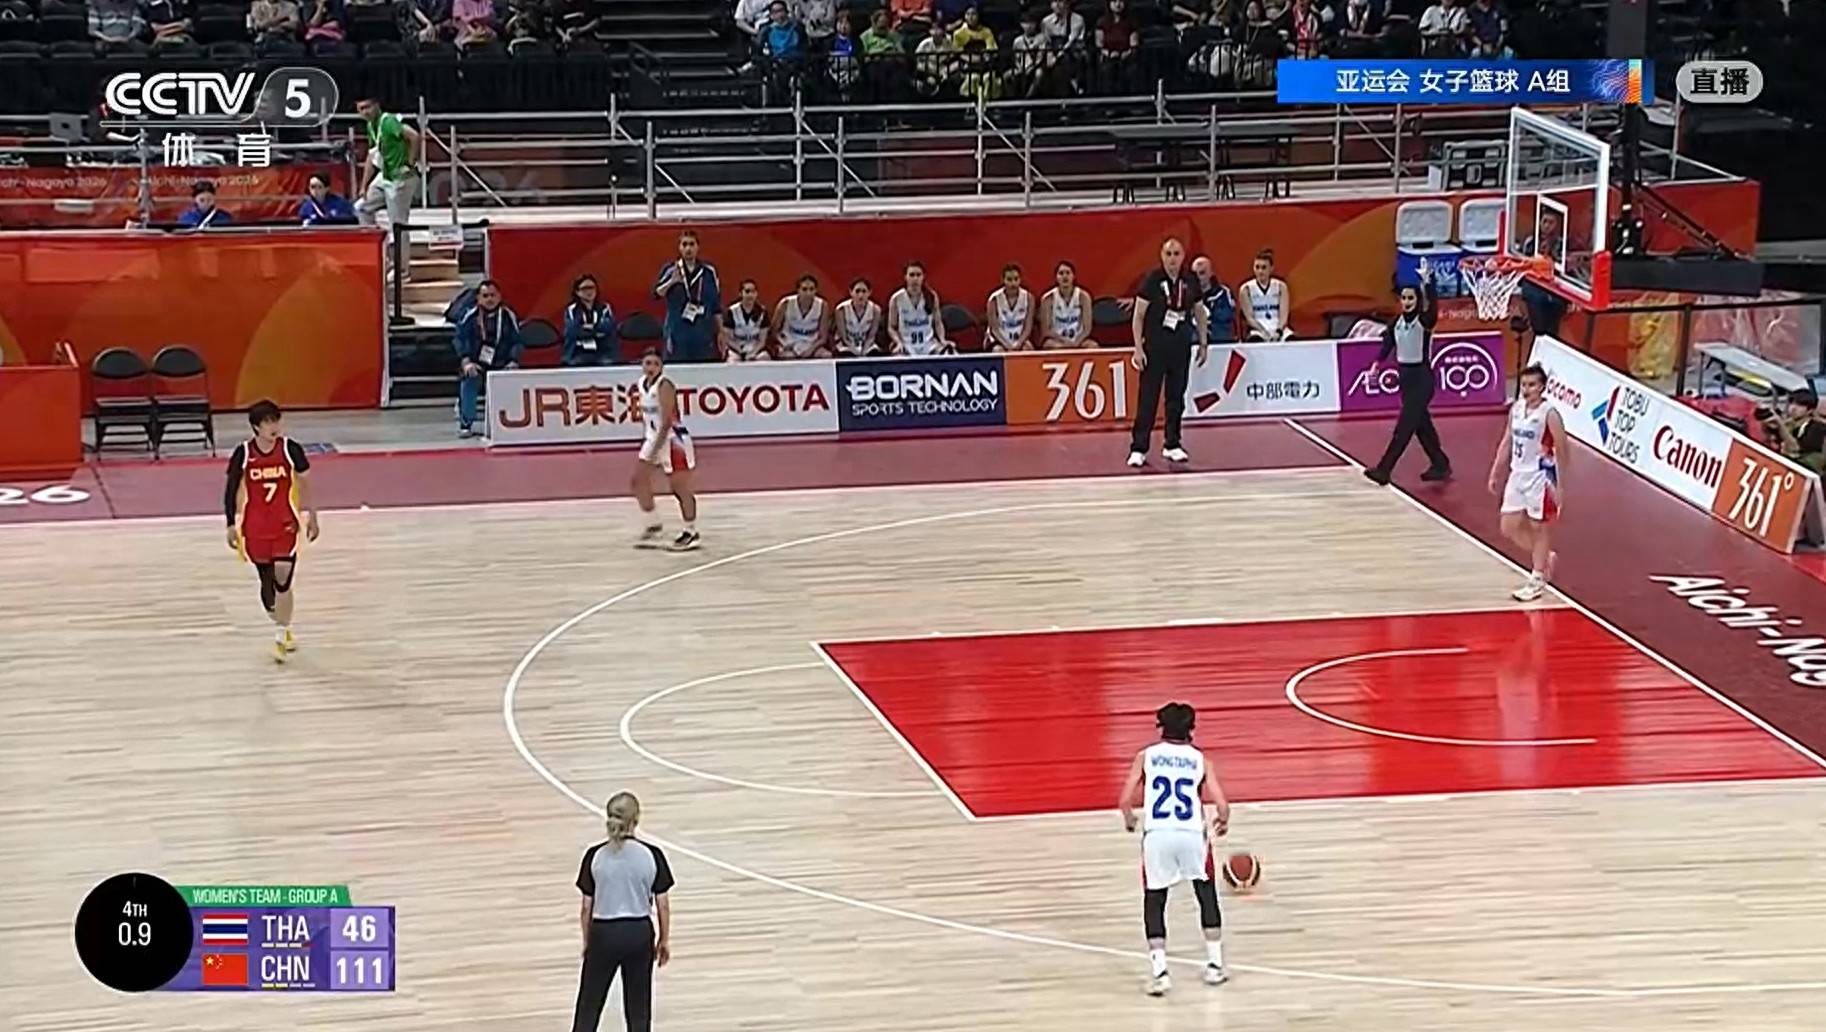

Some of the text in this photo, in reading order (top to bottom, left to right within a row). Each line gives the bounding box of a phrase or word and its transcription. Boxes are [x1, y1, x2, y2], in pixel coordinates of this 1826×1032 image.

[846, 371, 998, 400] BORNAN
[1246, 380, 1321, 401] 中部電力
[1440, 364, 1490, 391] 100
[676, 383, 830, 415] TOYOTA
[852, 398, 998, 417] SPORTS TECHNOLOGY
[1547, 378, 1582, 410] ocomo
[1622, 386, 1651, 417] TOBU
[1615, 408, 1637, 433] TOP
[1607, 431, 1640, 464] TOURS
[1653, 424, 1723, 489] Canon
[262, 482, 278, 503] 7
[1152, 775, 1194, 821] 25
